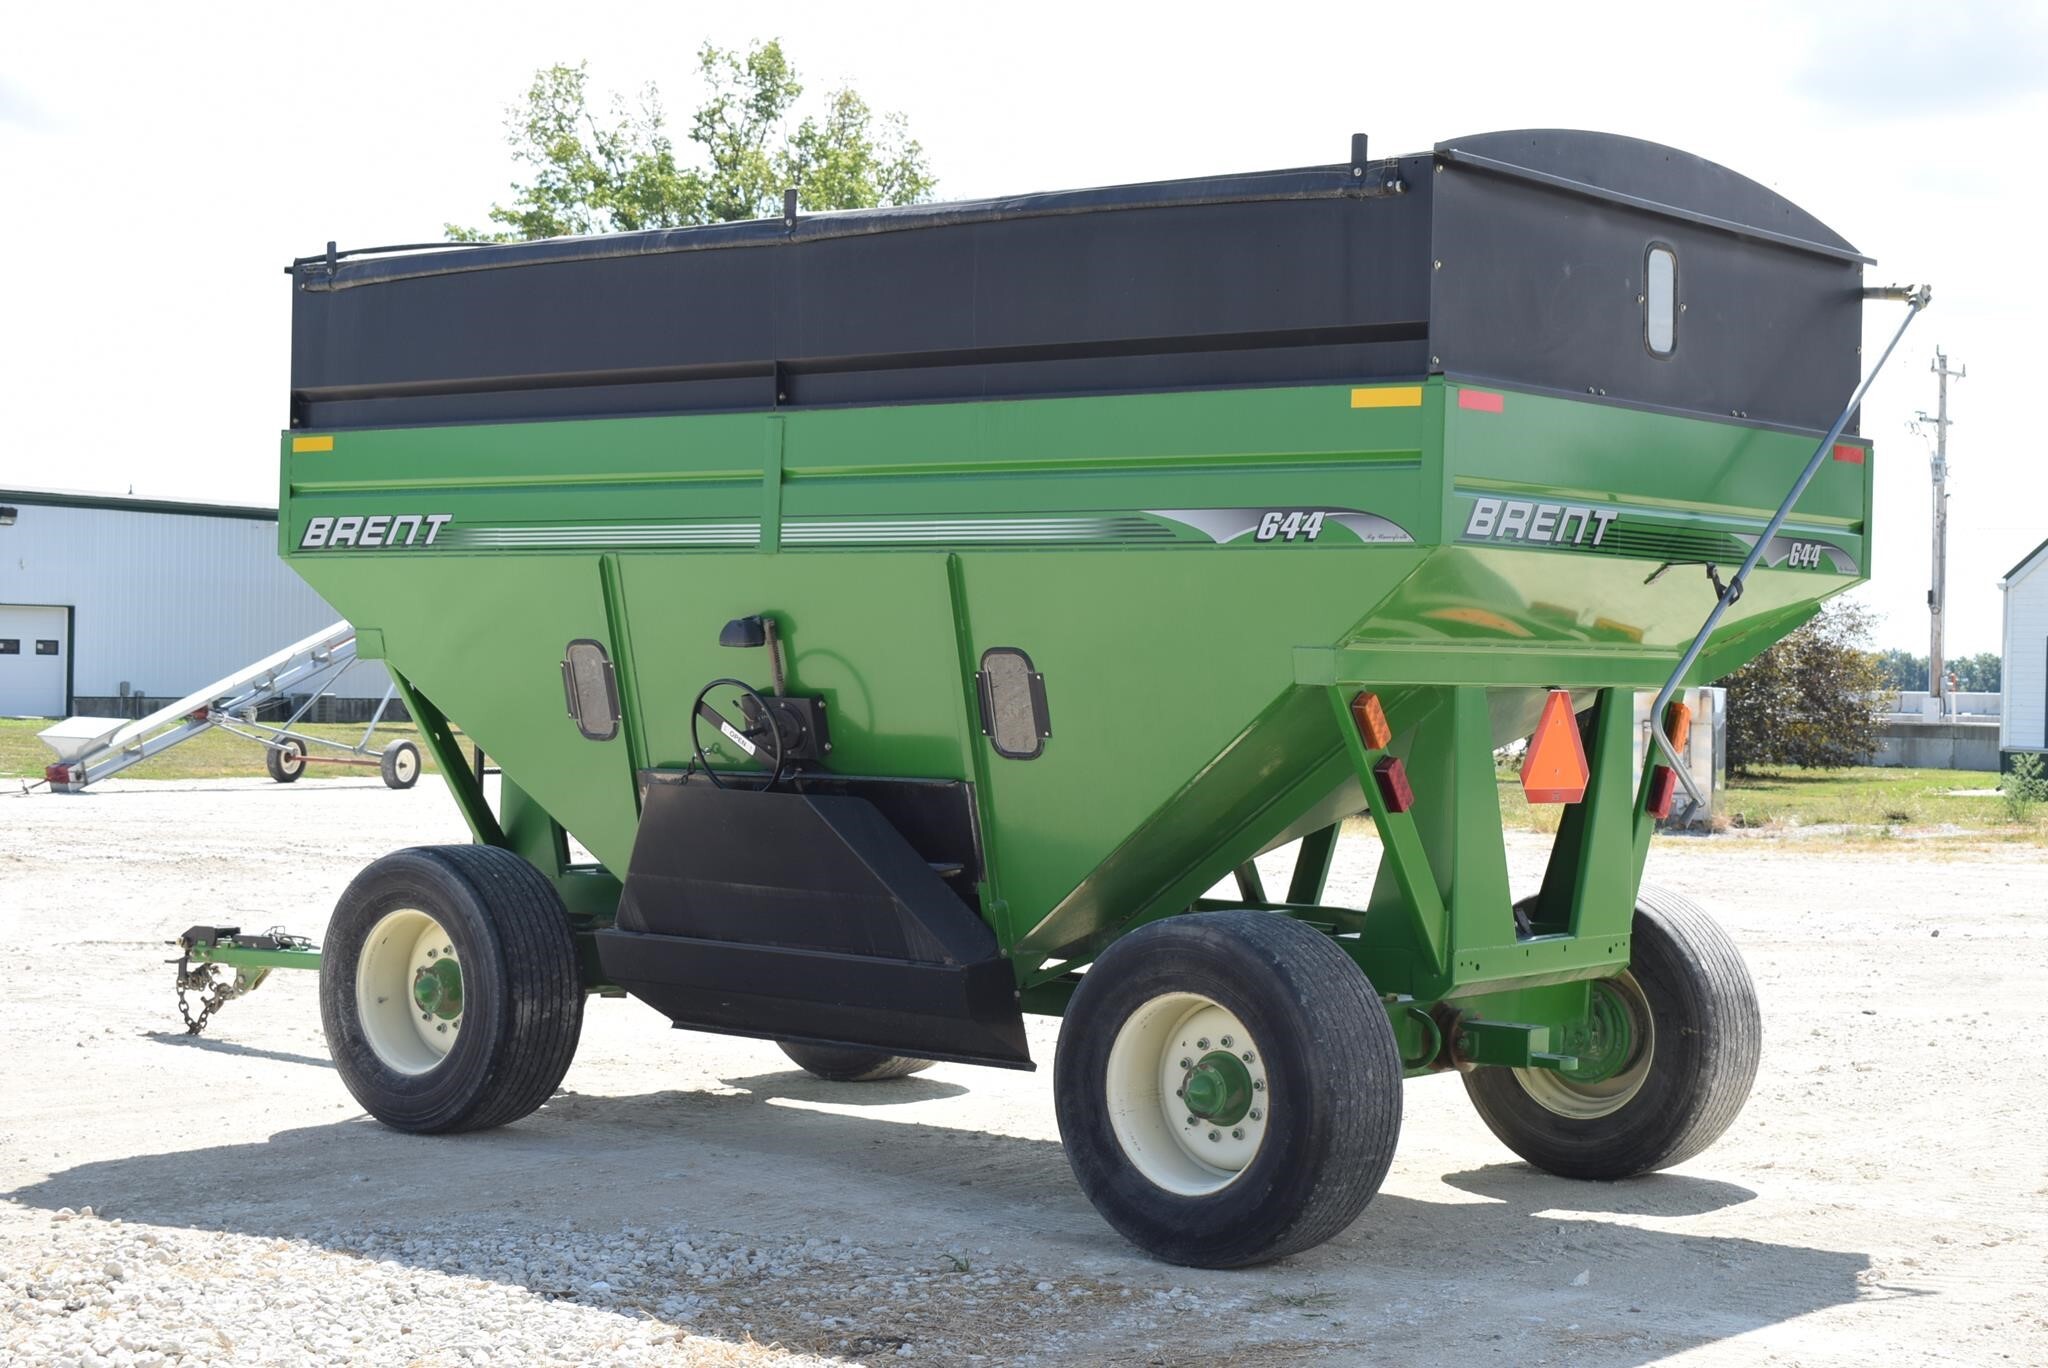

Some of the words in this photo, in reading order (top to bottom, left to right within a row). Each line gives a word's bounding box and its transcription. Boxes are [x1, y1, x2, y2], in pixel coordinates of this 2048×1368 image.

[300, 514, 453, 548] BRENT
[1255, 511, 1326, 541] 644
[1463, 497, 1619, 546] BRENT
[1788, 541, 1822, 569] 644
[729, 730, 748, 747] OPEN
